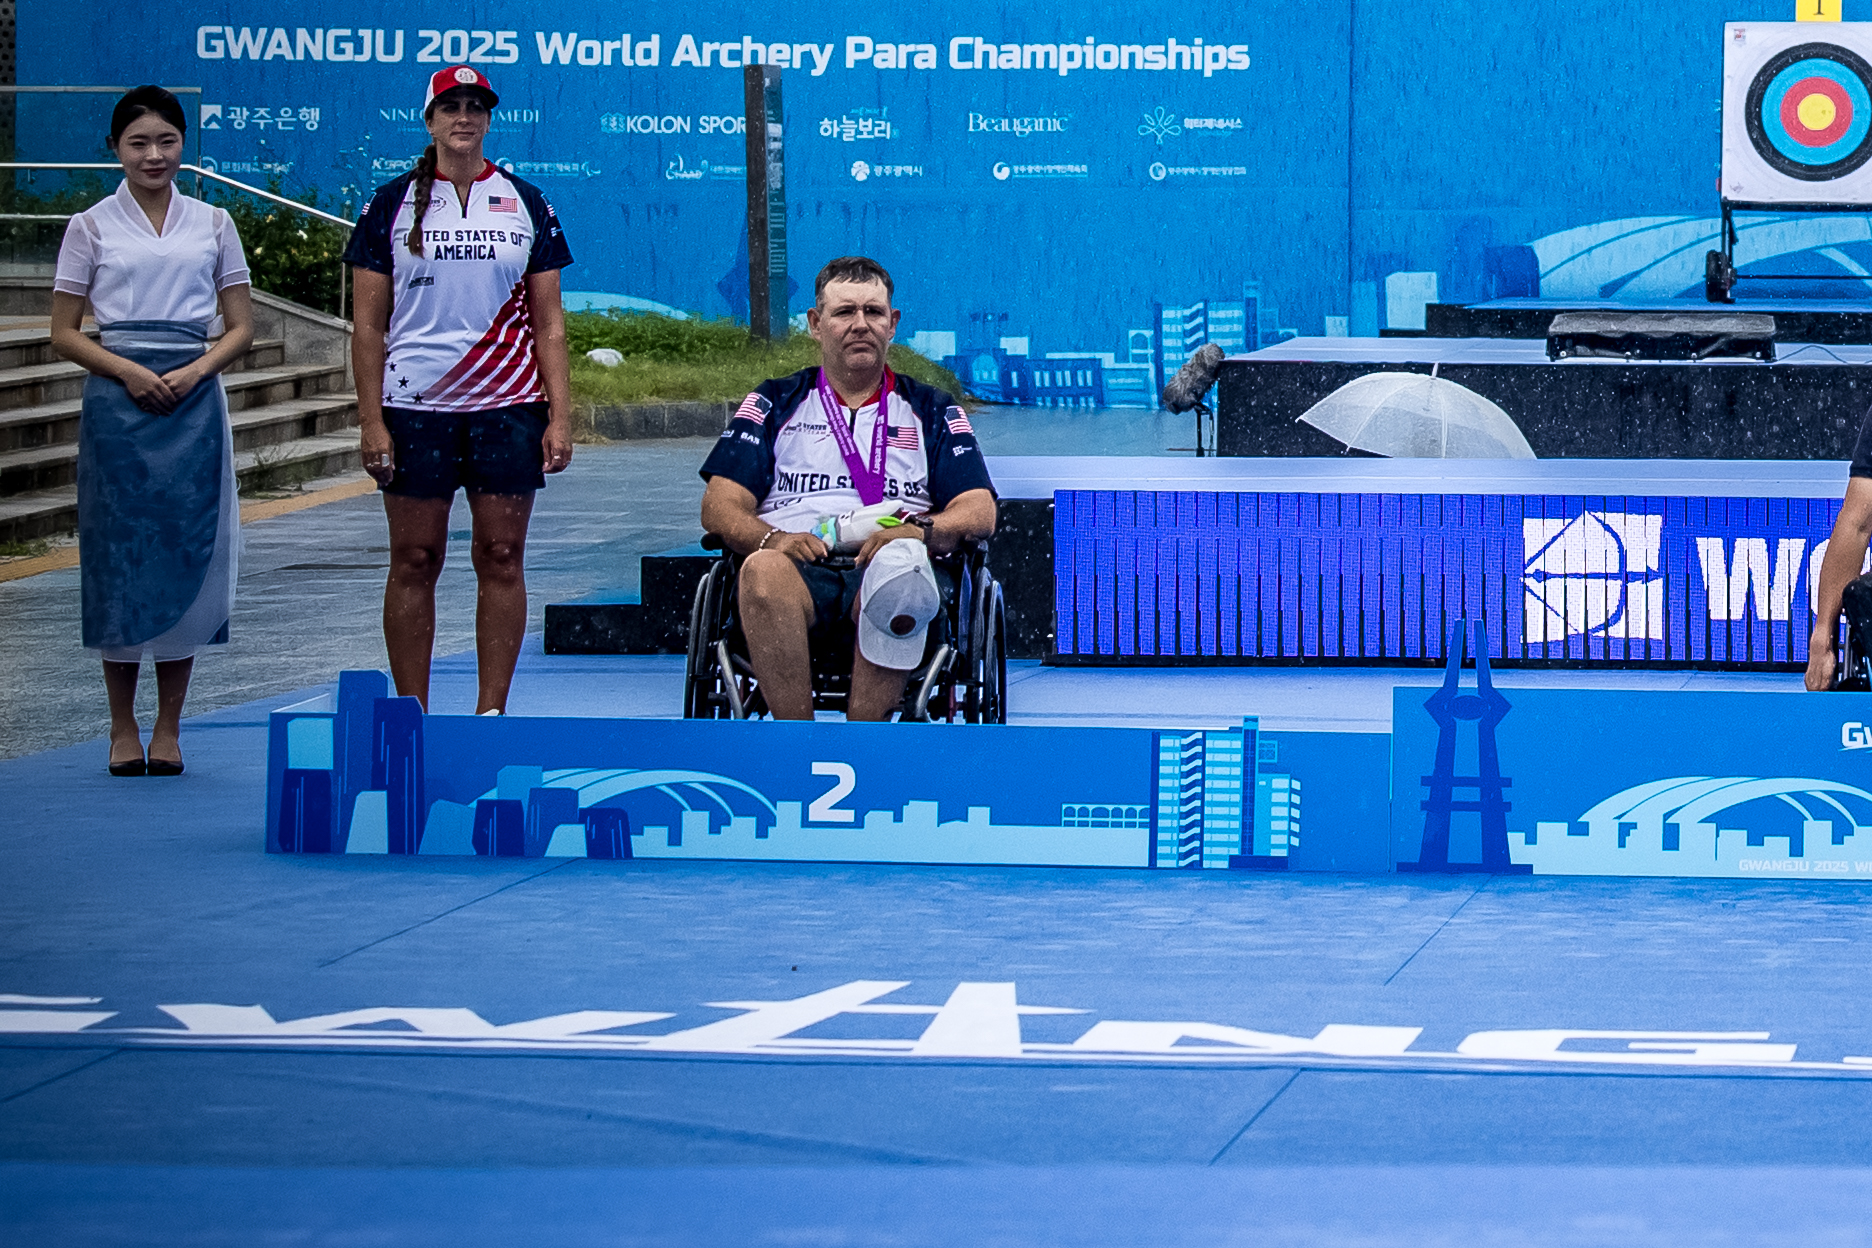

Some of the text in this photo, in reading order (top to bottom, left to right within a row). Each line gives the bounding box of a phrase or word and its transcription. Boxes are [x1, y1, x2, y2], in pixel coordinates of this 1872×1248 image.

[197, 25, 1251, 77] GWANGJU 2025 World Archery Para Championships
[226, 105, 320, 131] 광주은행
[625, 115, 747, 135] KOLON SPOR
[819, 114, 891, 142] 하늘보리
[967, 110, 1069, 138] Beauganic
[403, 229, 525, 247] TED STATES OF
[434, 244, 497, 261] AMERICA
[777, 471, 831, 493] UNITED
[807, 761, 856, 823] 2
[1739, 859, 1810, 874] GWANGJU
[1813, 860, 1849, 873] 2025
